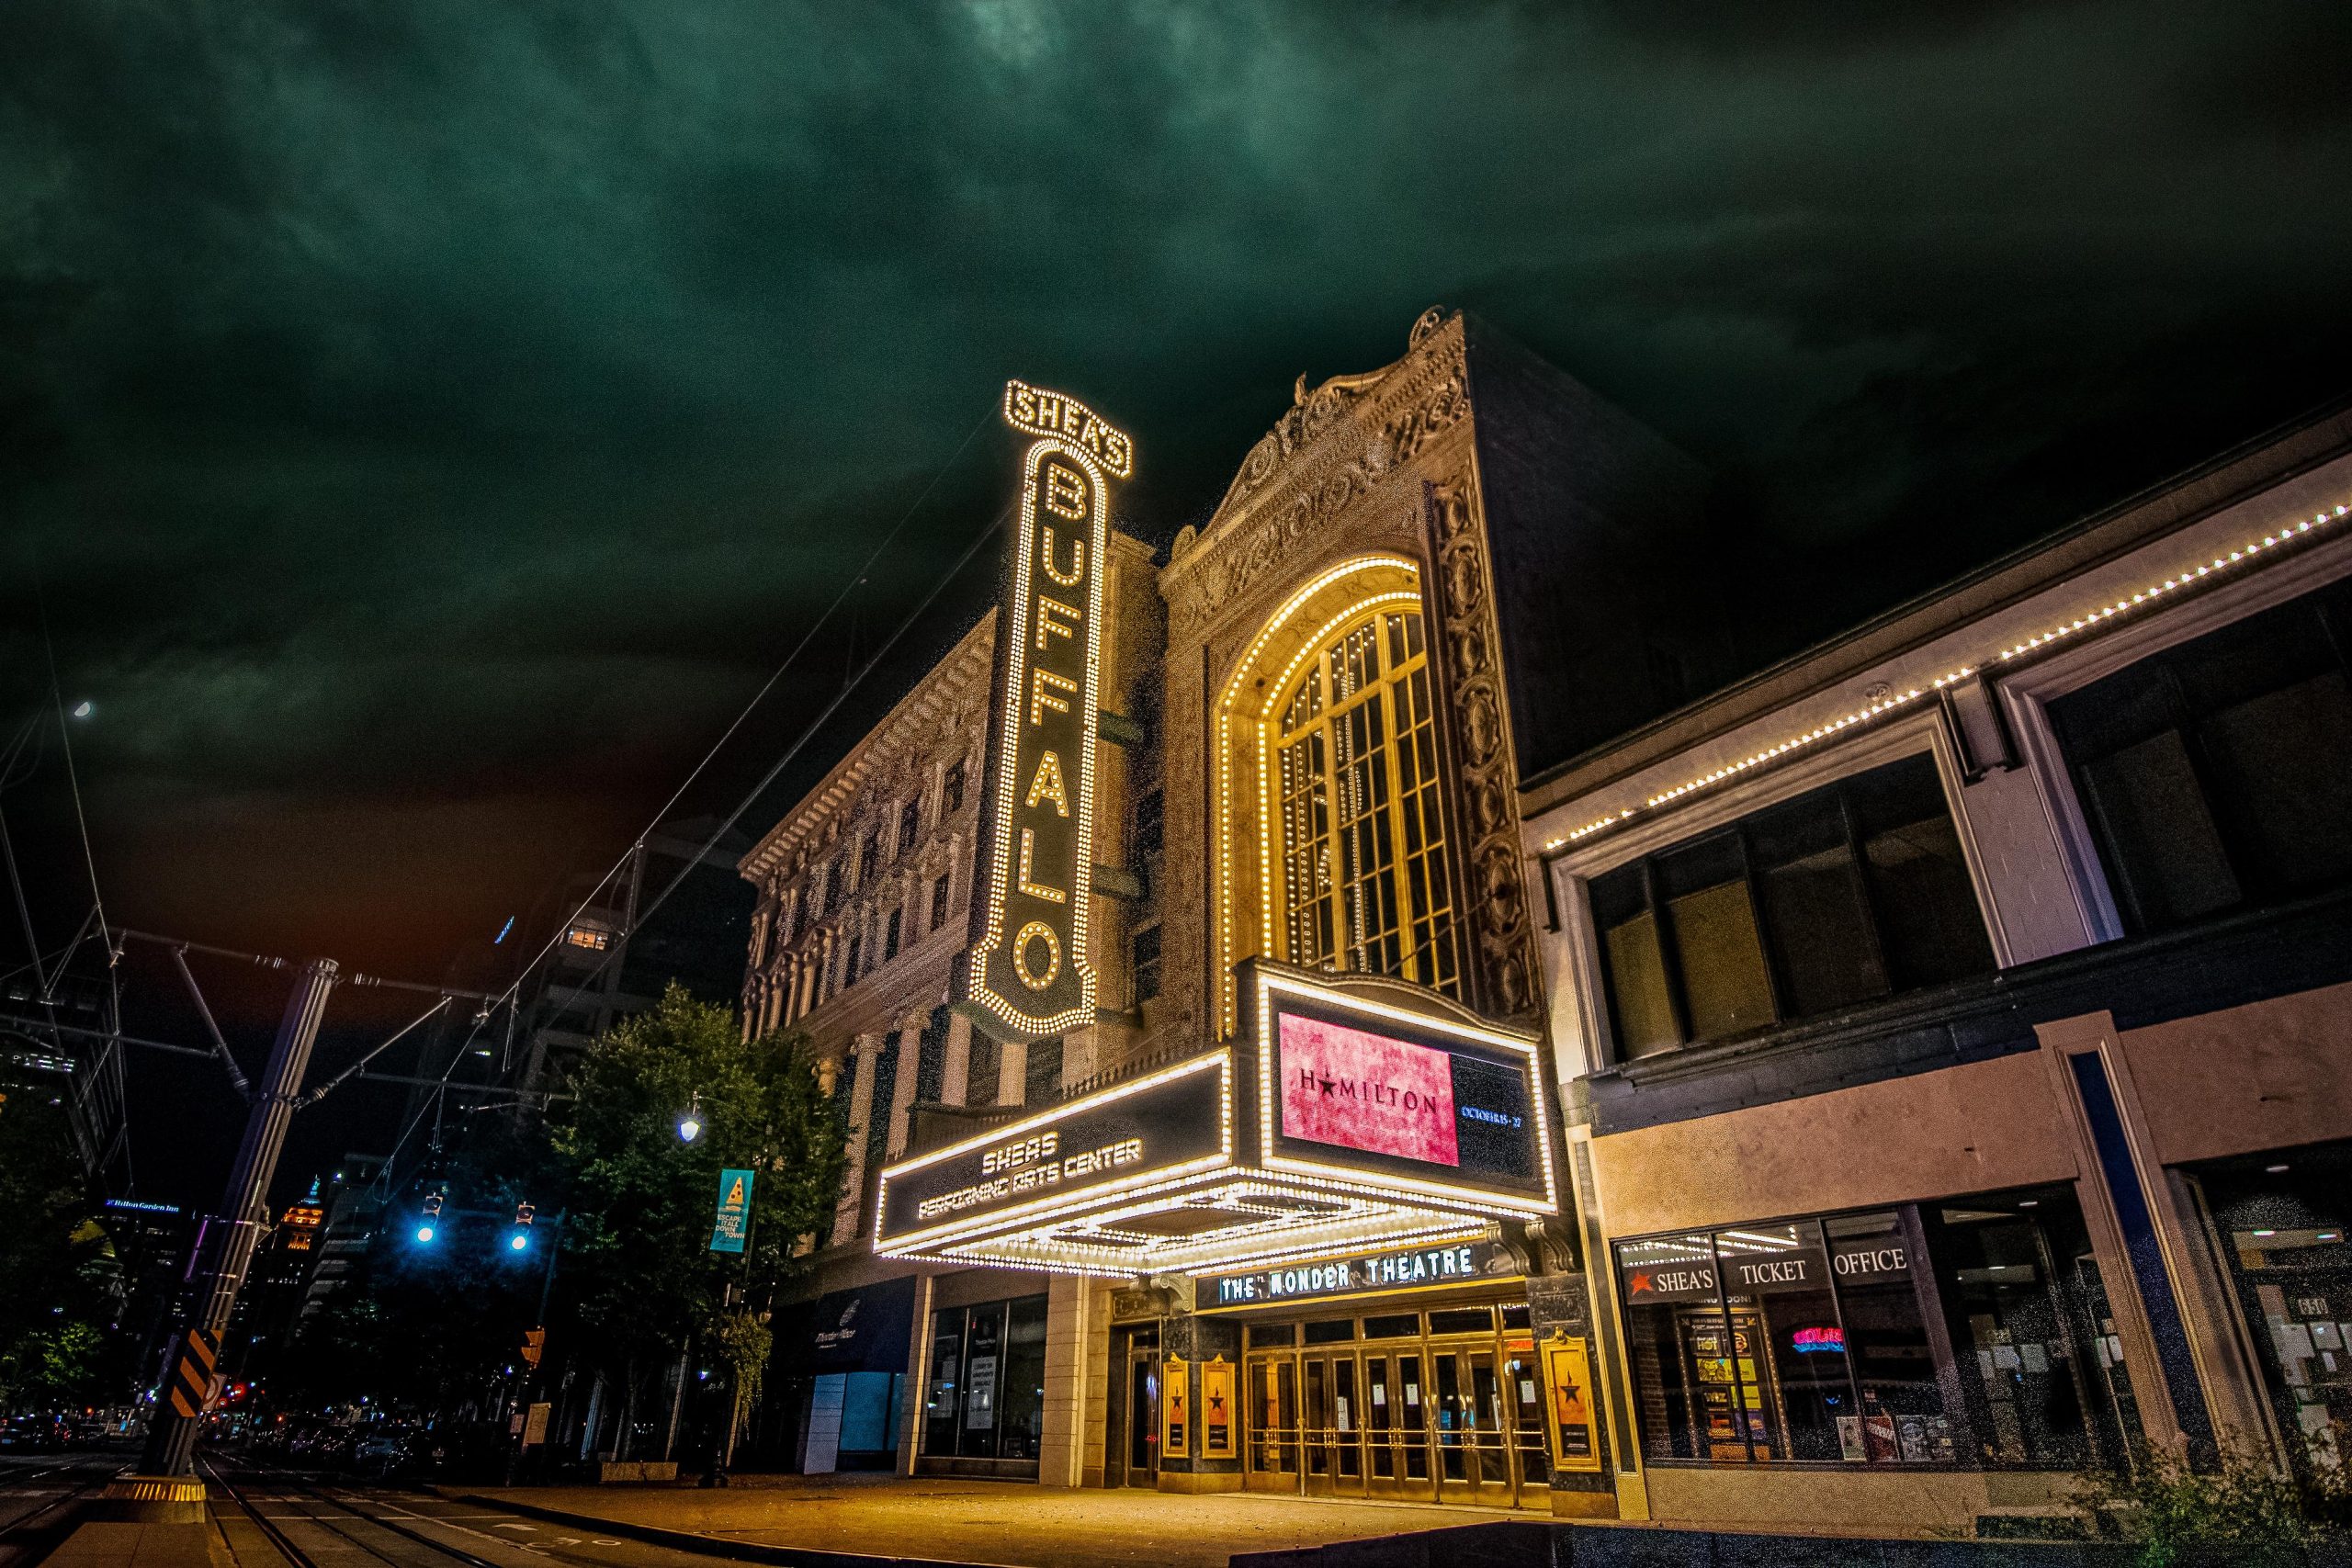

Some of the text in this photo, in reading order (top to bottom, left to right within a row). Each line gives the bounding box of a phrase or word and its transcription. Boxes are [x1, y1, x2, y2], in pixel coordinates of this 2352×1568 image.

[1014, 389, 1125, 467] SHEA'S
[1013, 462, 1087, 990] BUFFALO
[115, 1200, 138, 1208] Hilton
[140, 1202, 164, 1211] Garden
[918, 1137, 1143, 1220] PERFORMING ARTS CENTER
[1222, 1247, 1473, 1301] THE WONDER THEATRE
[1657, 1248, 1907, 1293] SHEA'S TICKET OFFICE
[1703, 1393, 1727, 1403] WIZ
